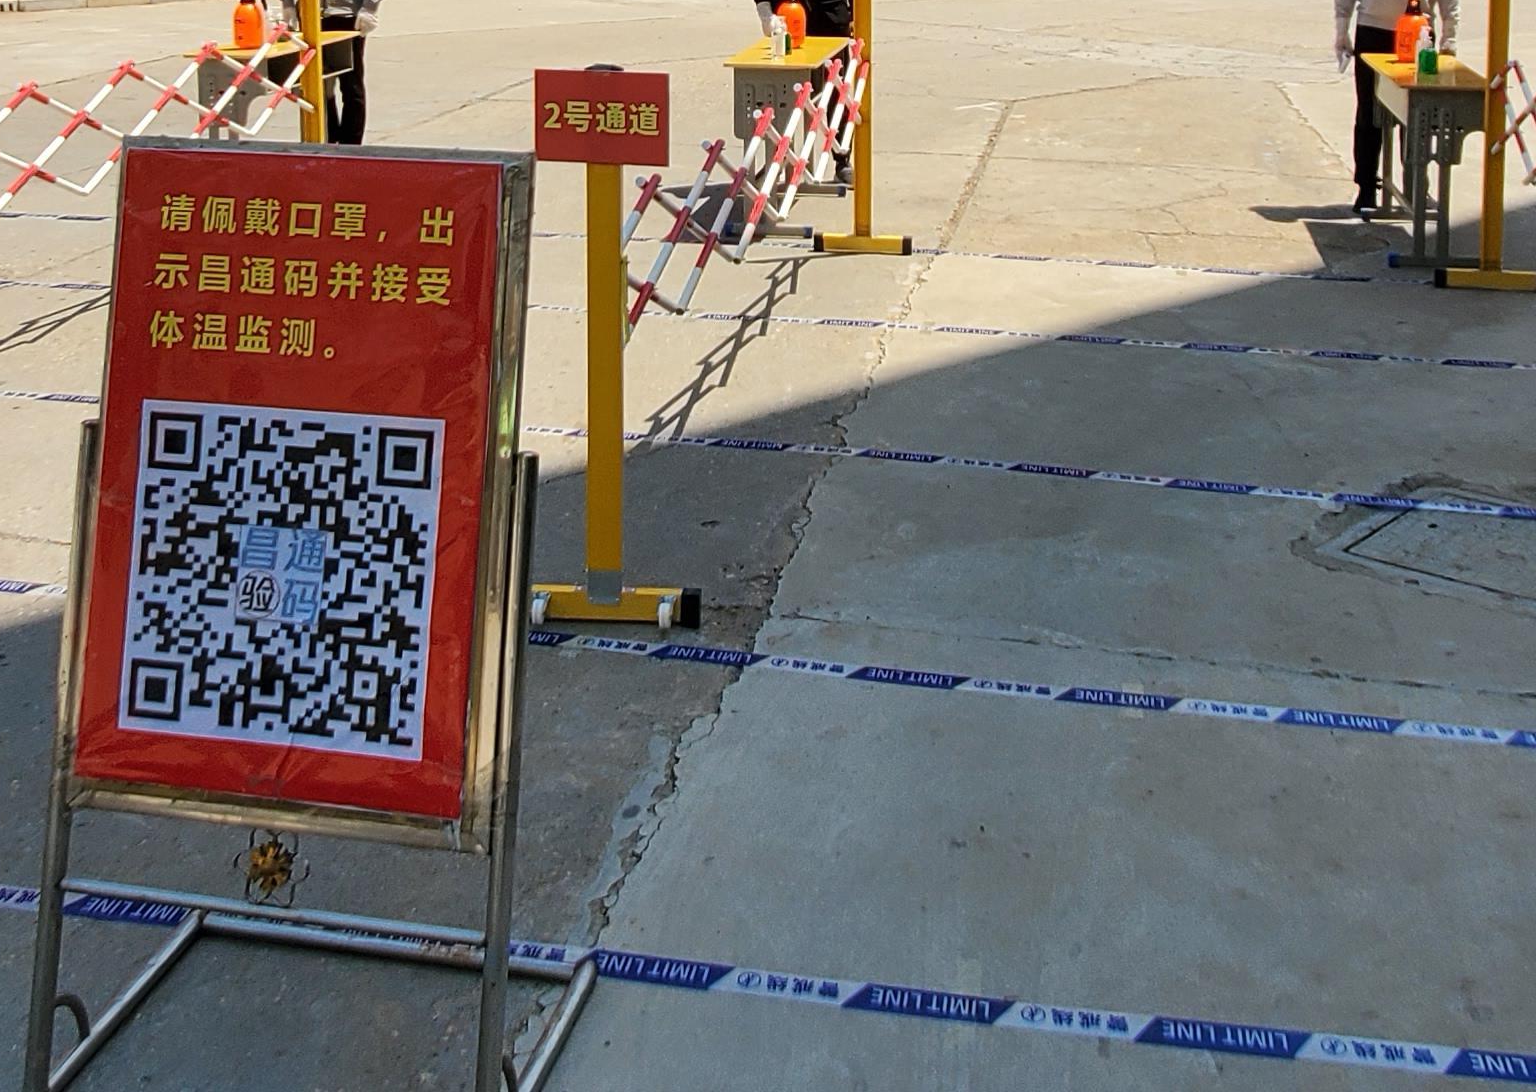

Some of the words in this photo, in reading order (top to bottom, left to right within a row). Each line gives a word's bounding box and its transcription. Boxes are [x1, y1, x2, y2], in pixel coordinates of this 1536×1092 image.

[543, 100, 660, 136] 2号通道
[160, 192, 457, 248] 请佩戴口罩，出
[153, 252, 453, 308] 示昌通码并接受
[148, 309, 339, 360] 体温监测。
[668, 646, 701, 658] LINE
[705, 650, 752, 664] LIMIT
[867, 668, 904, 681] LINE
[910, 672, 953, 686] LIMIT
[1075, 690, 1114, 704] LINE
[1120, 693, 1165, 708] LIMIT
[1294, 710, 1334, 725] LINE
[1339, 715, 1389, 731] LIMIT
[85, 895, 132, 916] LINE
[596, 952, 646, 975] LINE
[646, 959, 710, 985] LIMIT
[869, 987, 923, 1007] LINE
[927, 994, 990, 1019] LIMIT
[1162, 1019, 1217, 1043] LINE
[1225, 1026, 1289, 1053] LIMIT
[1469, 1052, 1530, 1077] LINE
